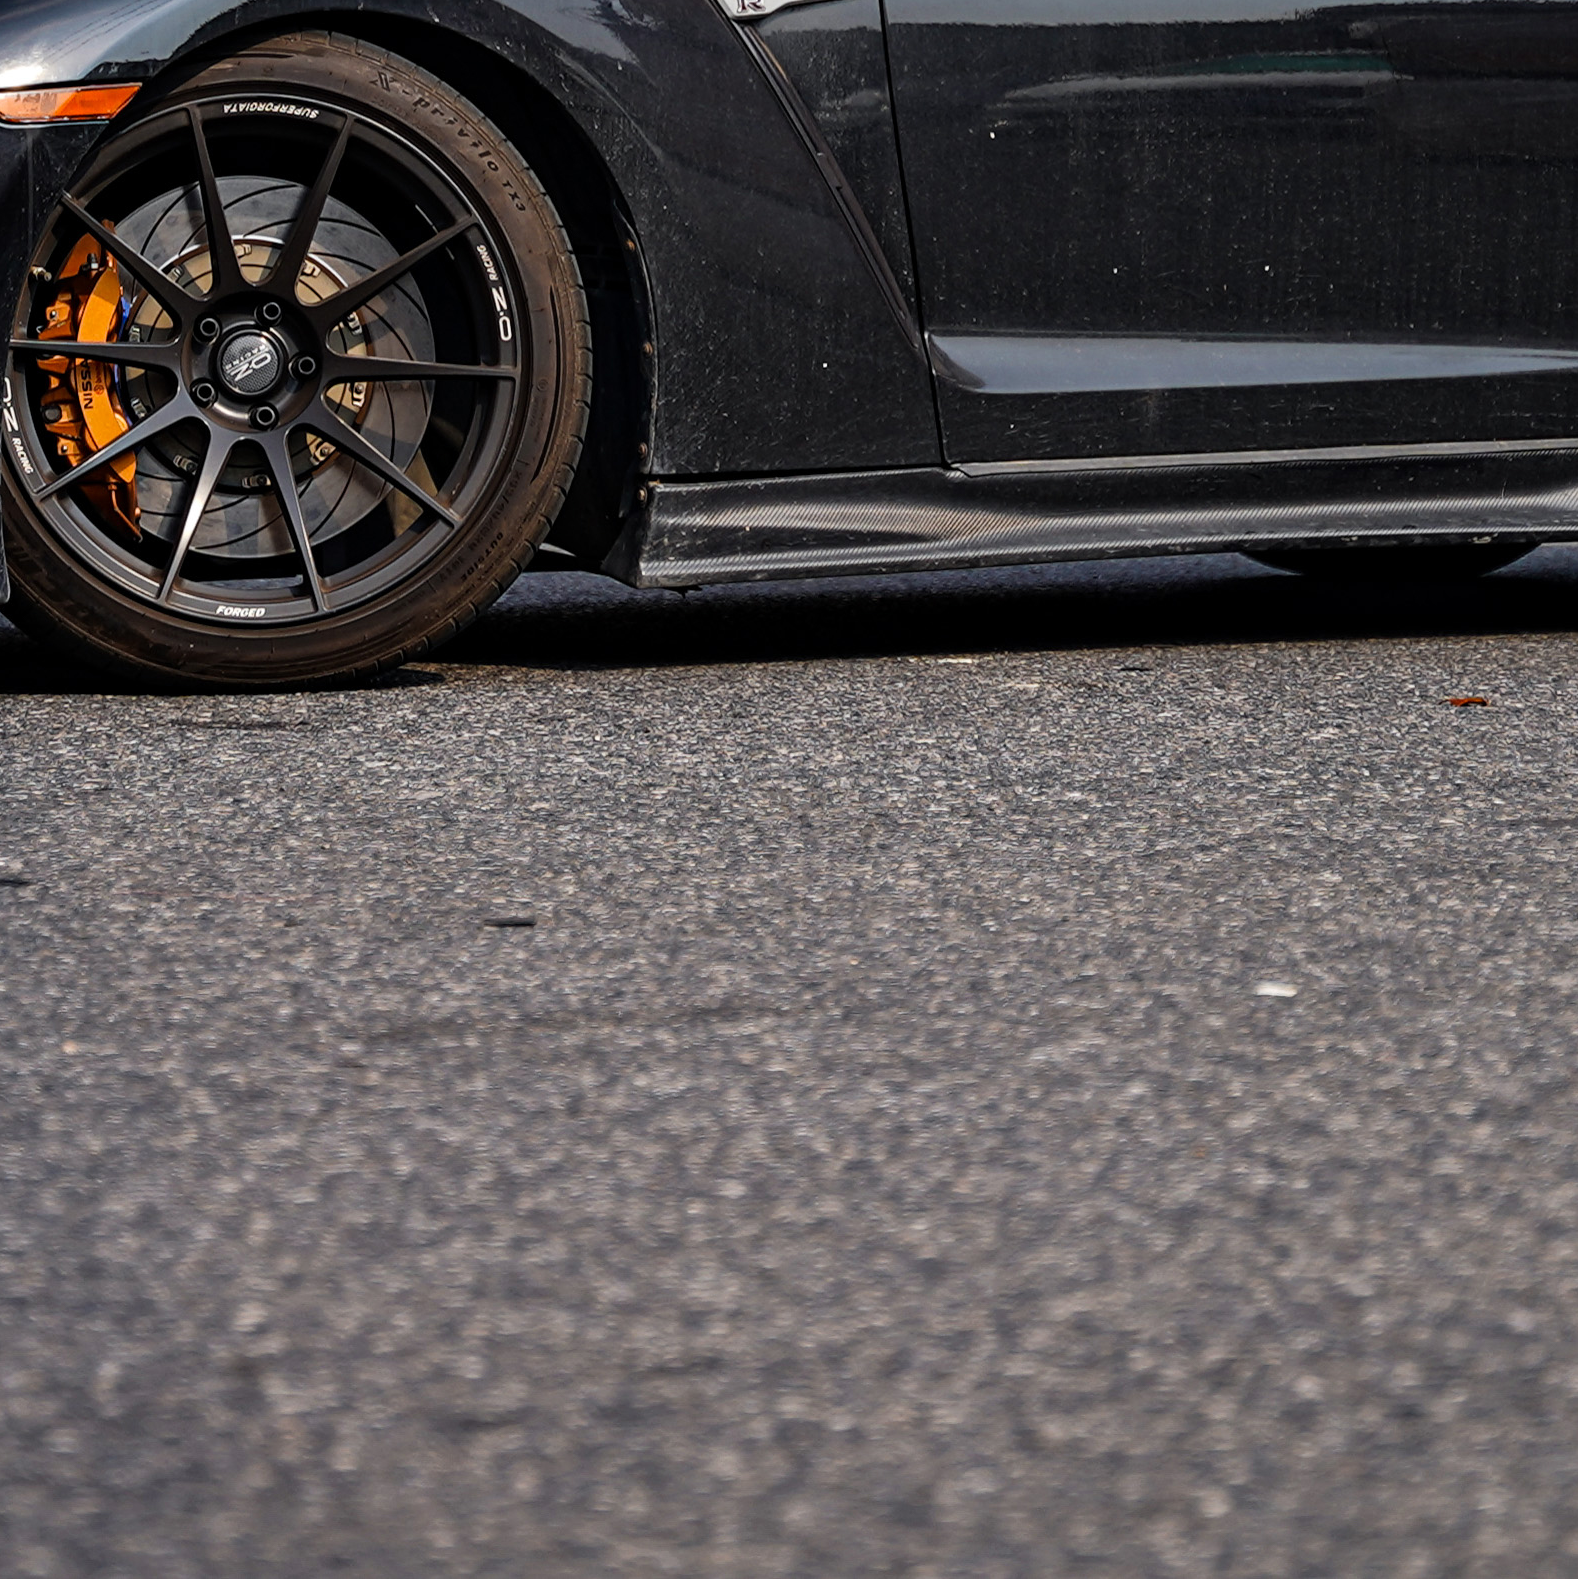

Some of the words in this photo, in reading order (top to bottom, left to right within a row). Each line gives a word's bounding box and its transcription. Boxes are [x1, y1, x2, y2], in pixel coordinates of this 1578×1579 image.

[223, 102, 319, 119] SUPERFORGIATA
[476, 244, 498, 281] RACING
[80, 358, 94, 410] NISSA
[12, 437, 34, 474] RACING
[216, 605, 266, 618] FORGED
